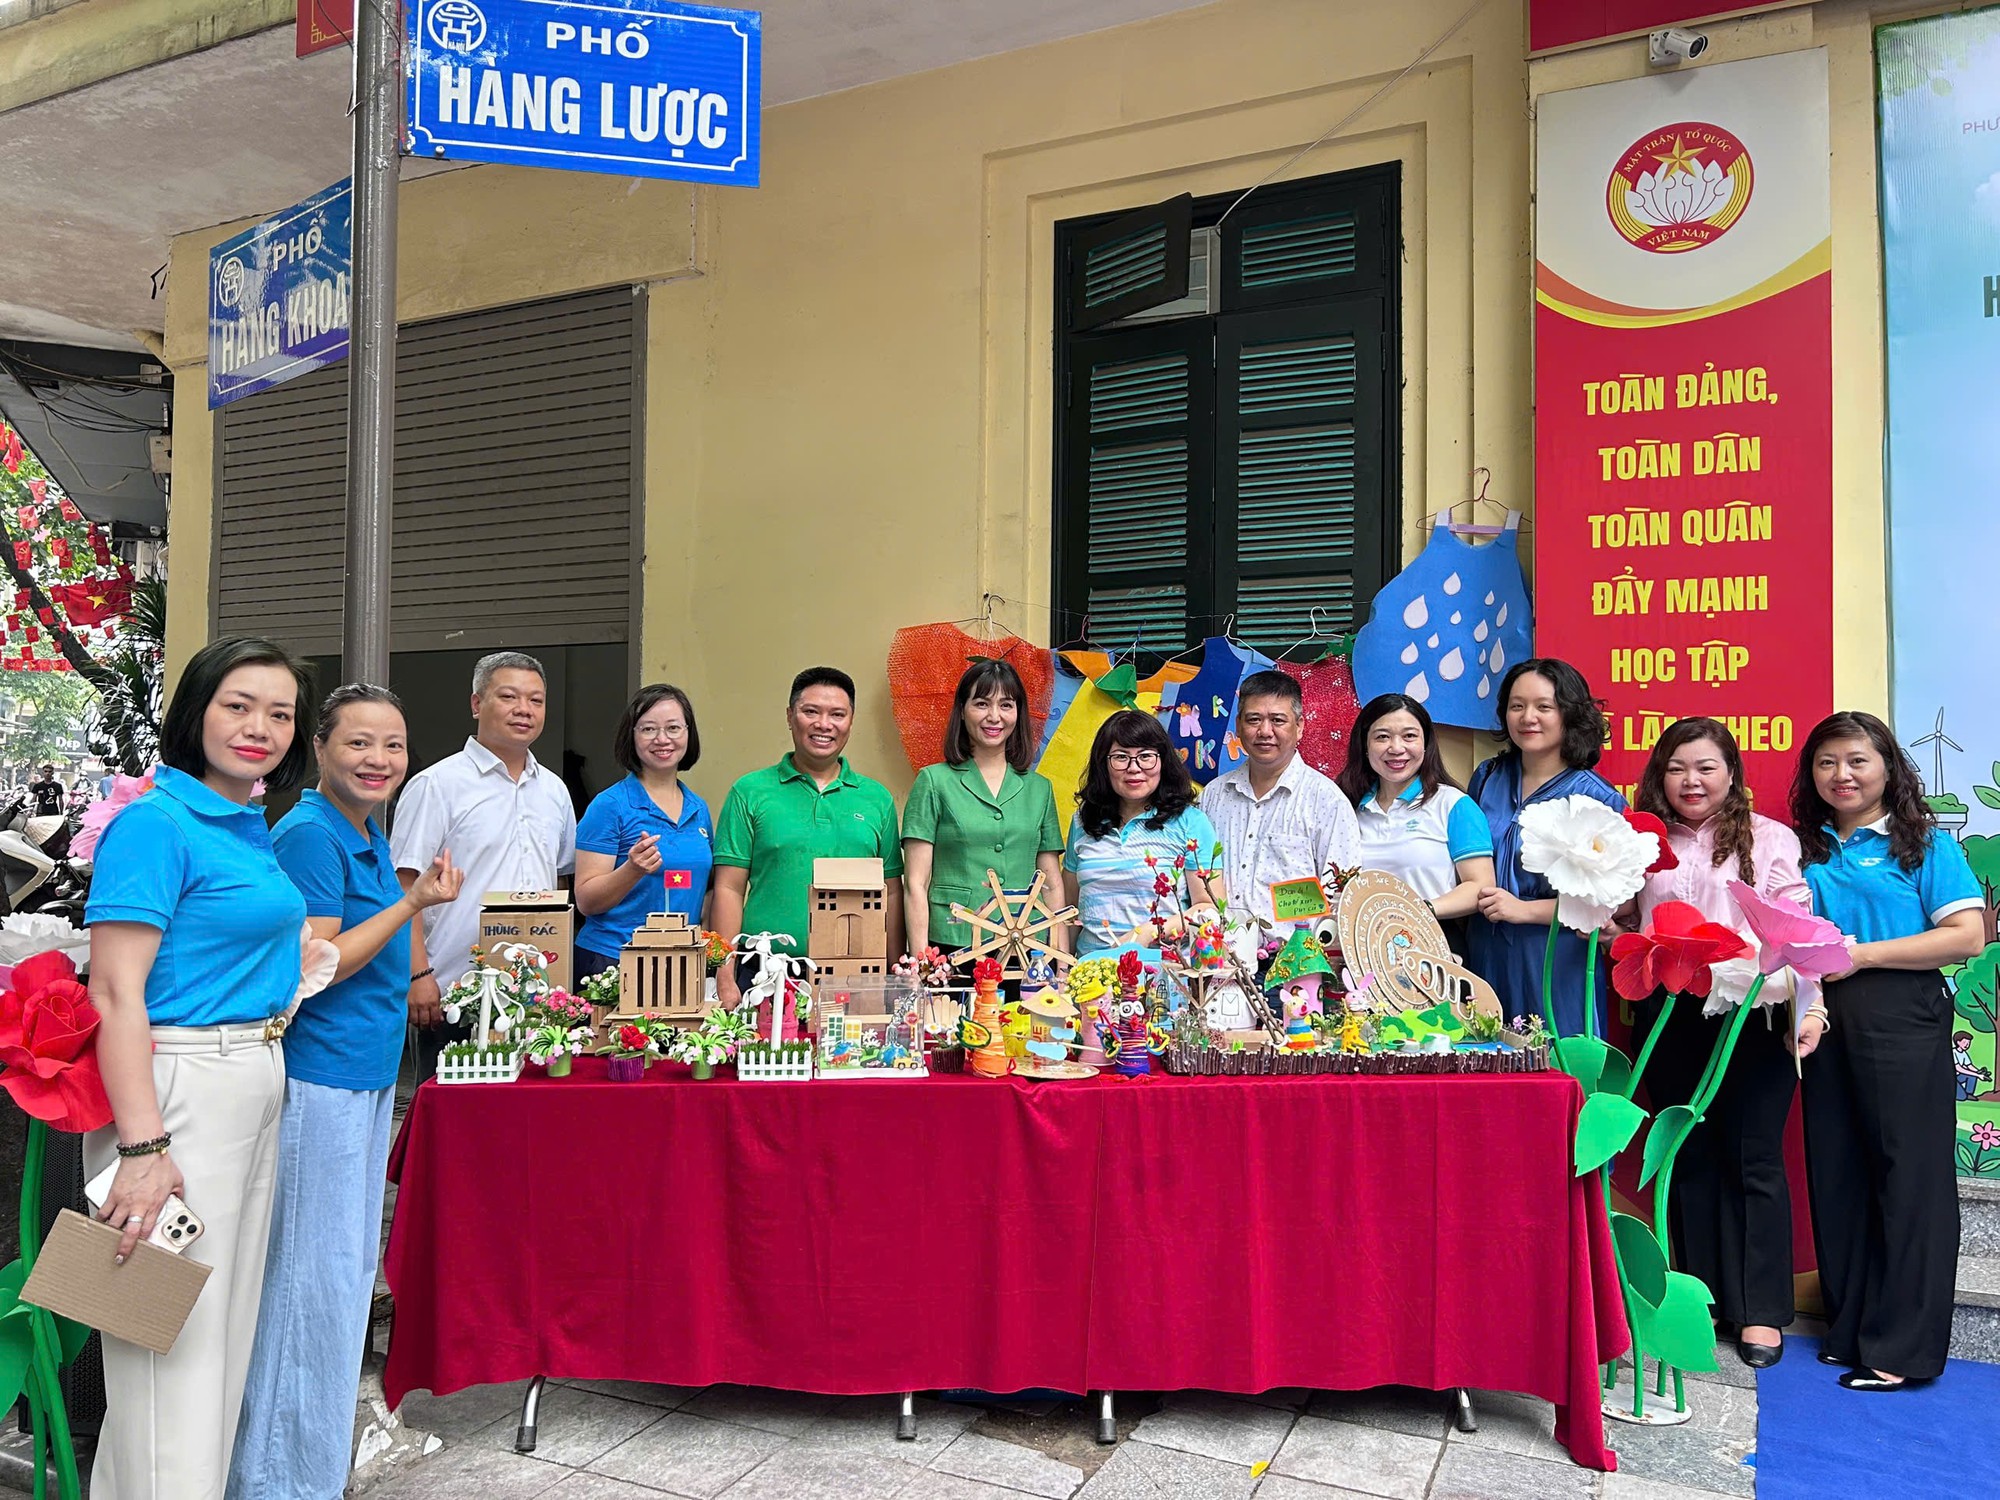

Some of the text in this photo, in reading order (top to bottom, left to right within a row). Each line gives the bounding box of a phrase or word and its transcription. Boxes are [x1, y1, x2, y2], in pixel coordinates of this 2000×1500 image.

[546, 20, 653, 59] PHỐ
[439, 53, 728, 158] HÀNG LƯỢC
[273, 209, 324, 271] PHỐ
[1647, 228, 1710, 246] VIỆT NAM
[222, 271, 348, 374] HÀNG KHOA
[1583, 362, 1778, 416] TOÀN ĐẢNG,
[1599, 432, 1761, 481] TOÀN DÂN
[1588, 500, 1773, 549] TOÀN QUÂN
[1592, 565, 1769, 619] ĐẨY MẠNH
[1611, 639, 1750, 689] HỌC TẬP
[483, 922, 558, 936] THÙNG RÁC
